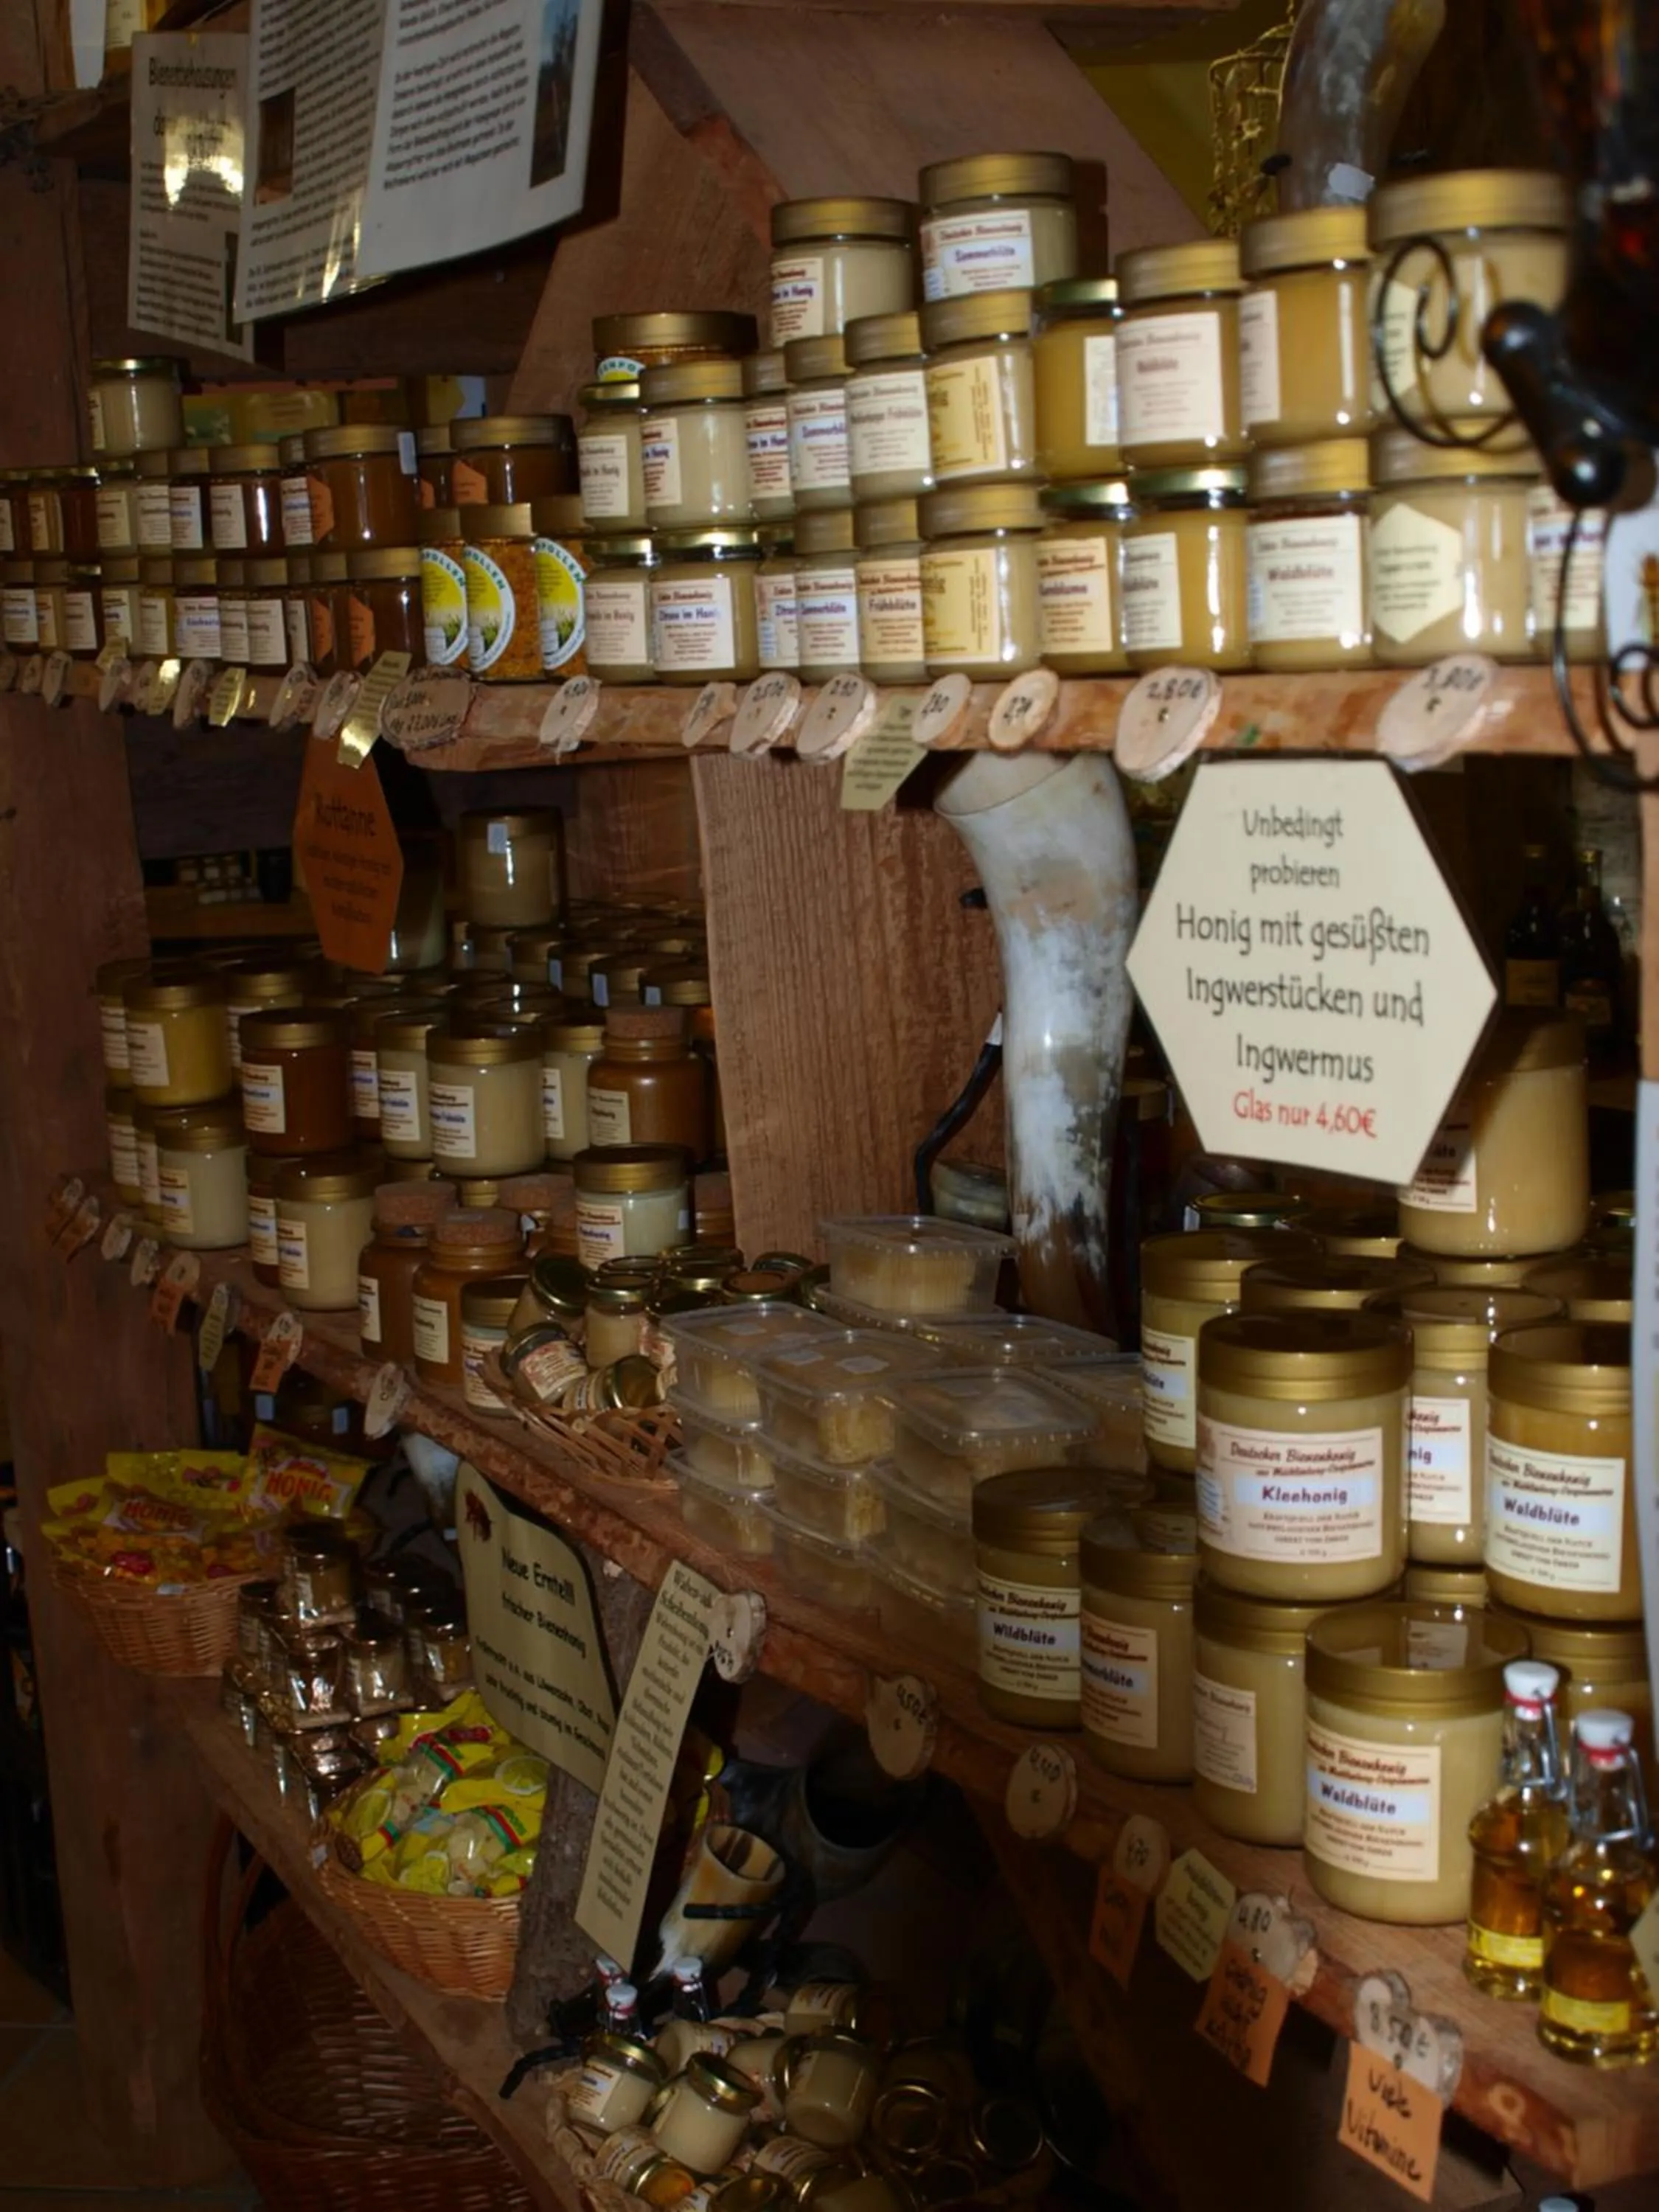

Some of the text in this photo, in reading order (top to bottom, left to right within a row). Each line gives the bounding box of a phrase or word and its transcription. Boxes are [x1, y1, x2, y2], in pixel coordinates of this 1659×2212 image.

[1242, 805, 1343, 847] Unbedingt
[1250, 855, 1340, 893] probieren
[1175, 902, 1430, 964] Honig mit gesüßten
[1186, 967, 1424, 1026] Ingwerstücken und
[1237, 1034, 1374, 1084] Ingwermus
[1233, 1089, 1377, 1138] Glas nur 4,60€
[1262, 1485, 1349, 1505] Kleehonig
[1503, 1496, 1580, 1526] Waldblüte
[992, 1622, 1057, 1646] Wildblüte
[1321, 1782, 1397, 1815] Waldblüte
